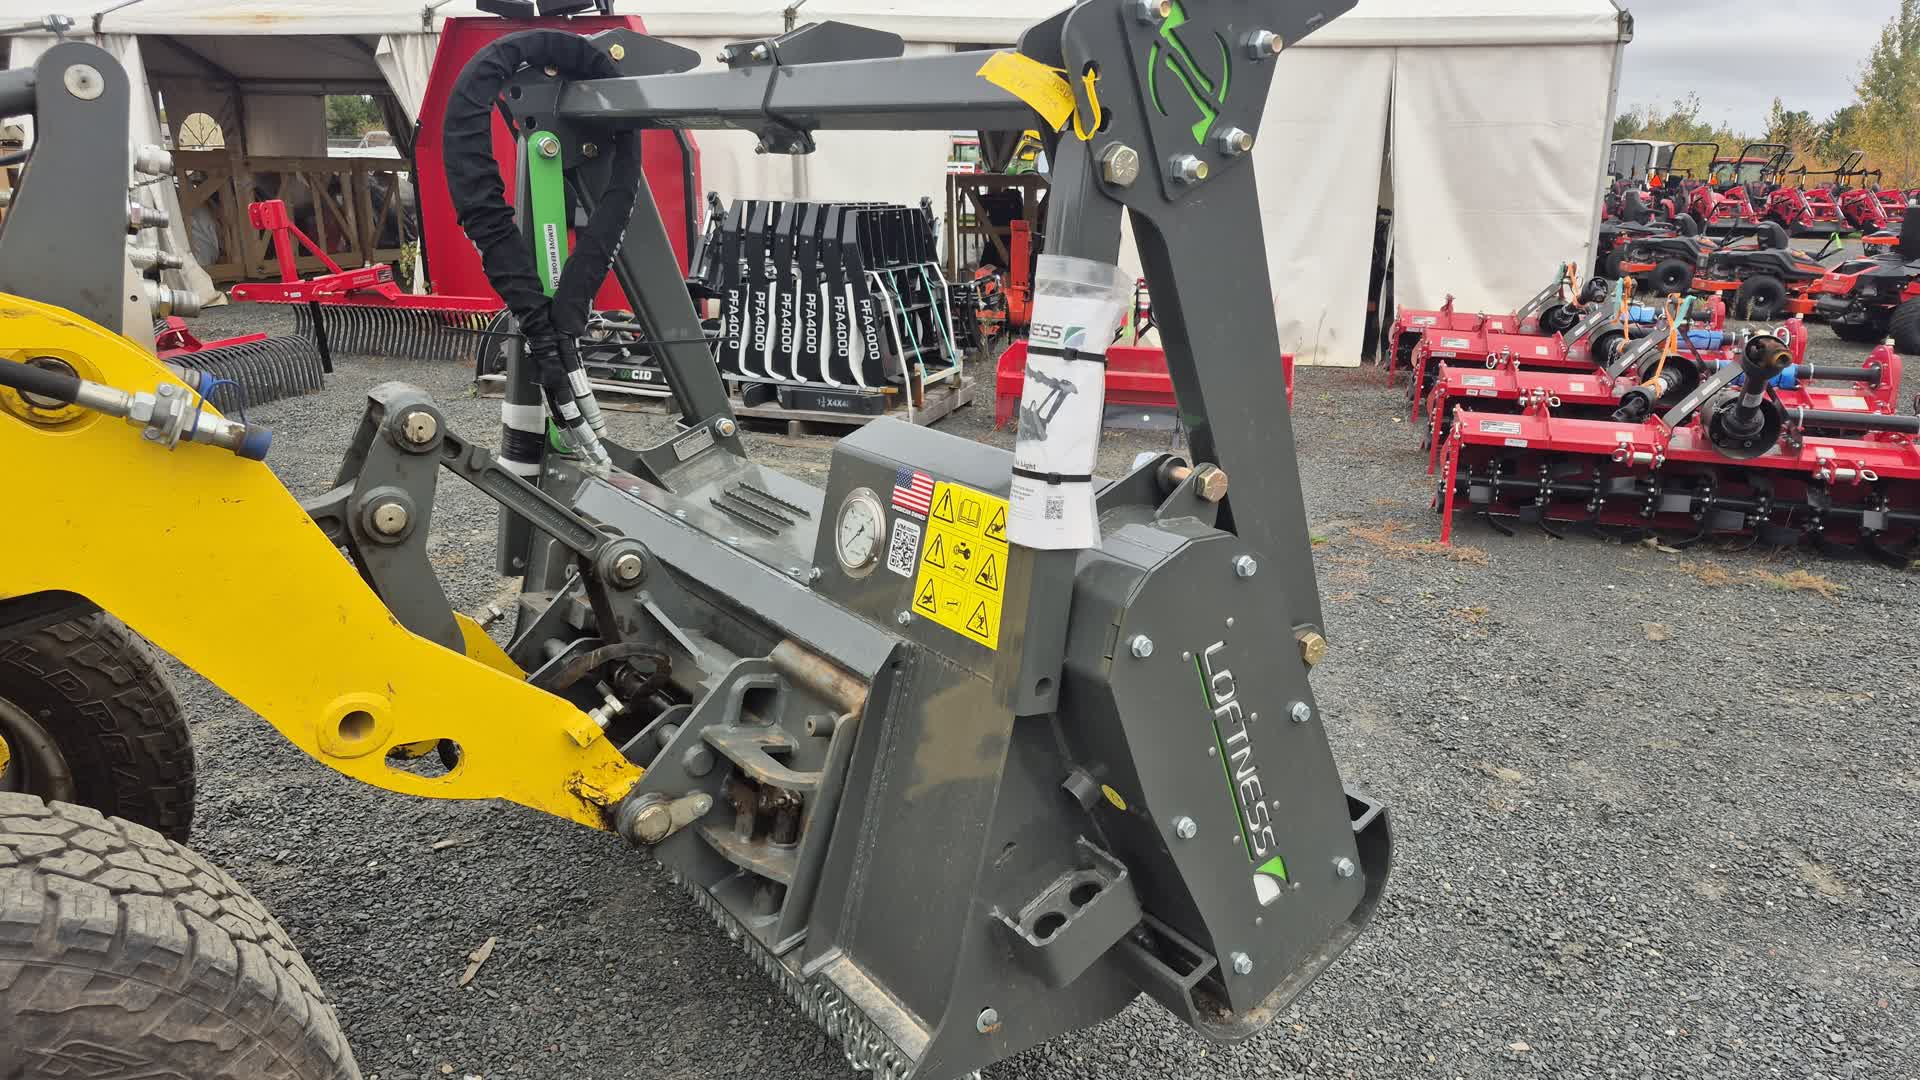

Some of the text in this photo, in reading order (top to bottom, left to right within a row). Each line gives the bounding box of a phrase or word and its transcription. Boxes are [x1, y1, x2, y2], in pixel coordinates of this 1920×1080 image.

[547, 224, 556, 250] REMOVE
[550, 251, 558, 275] BEFORE
[728, 289, 739, 350] PFA4000
[755, 291, 766, 352] PFA4000
[781, 293, 792, 354] PFA4000
[805, 293, 817, 354] PFA4000
[834, 296, 849, 357] PFA4000
[859, 299, 880, 360] PFA4000
[631, 369, 652, 380] CID
[1204, 640, 1277, 857] LOFTNESS
